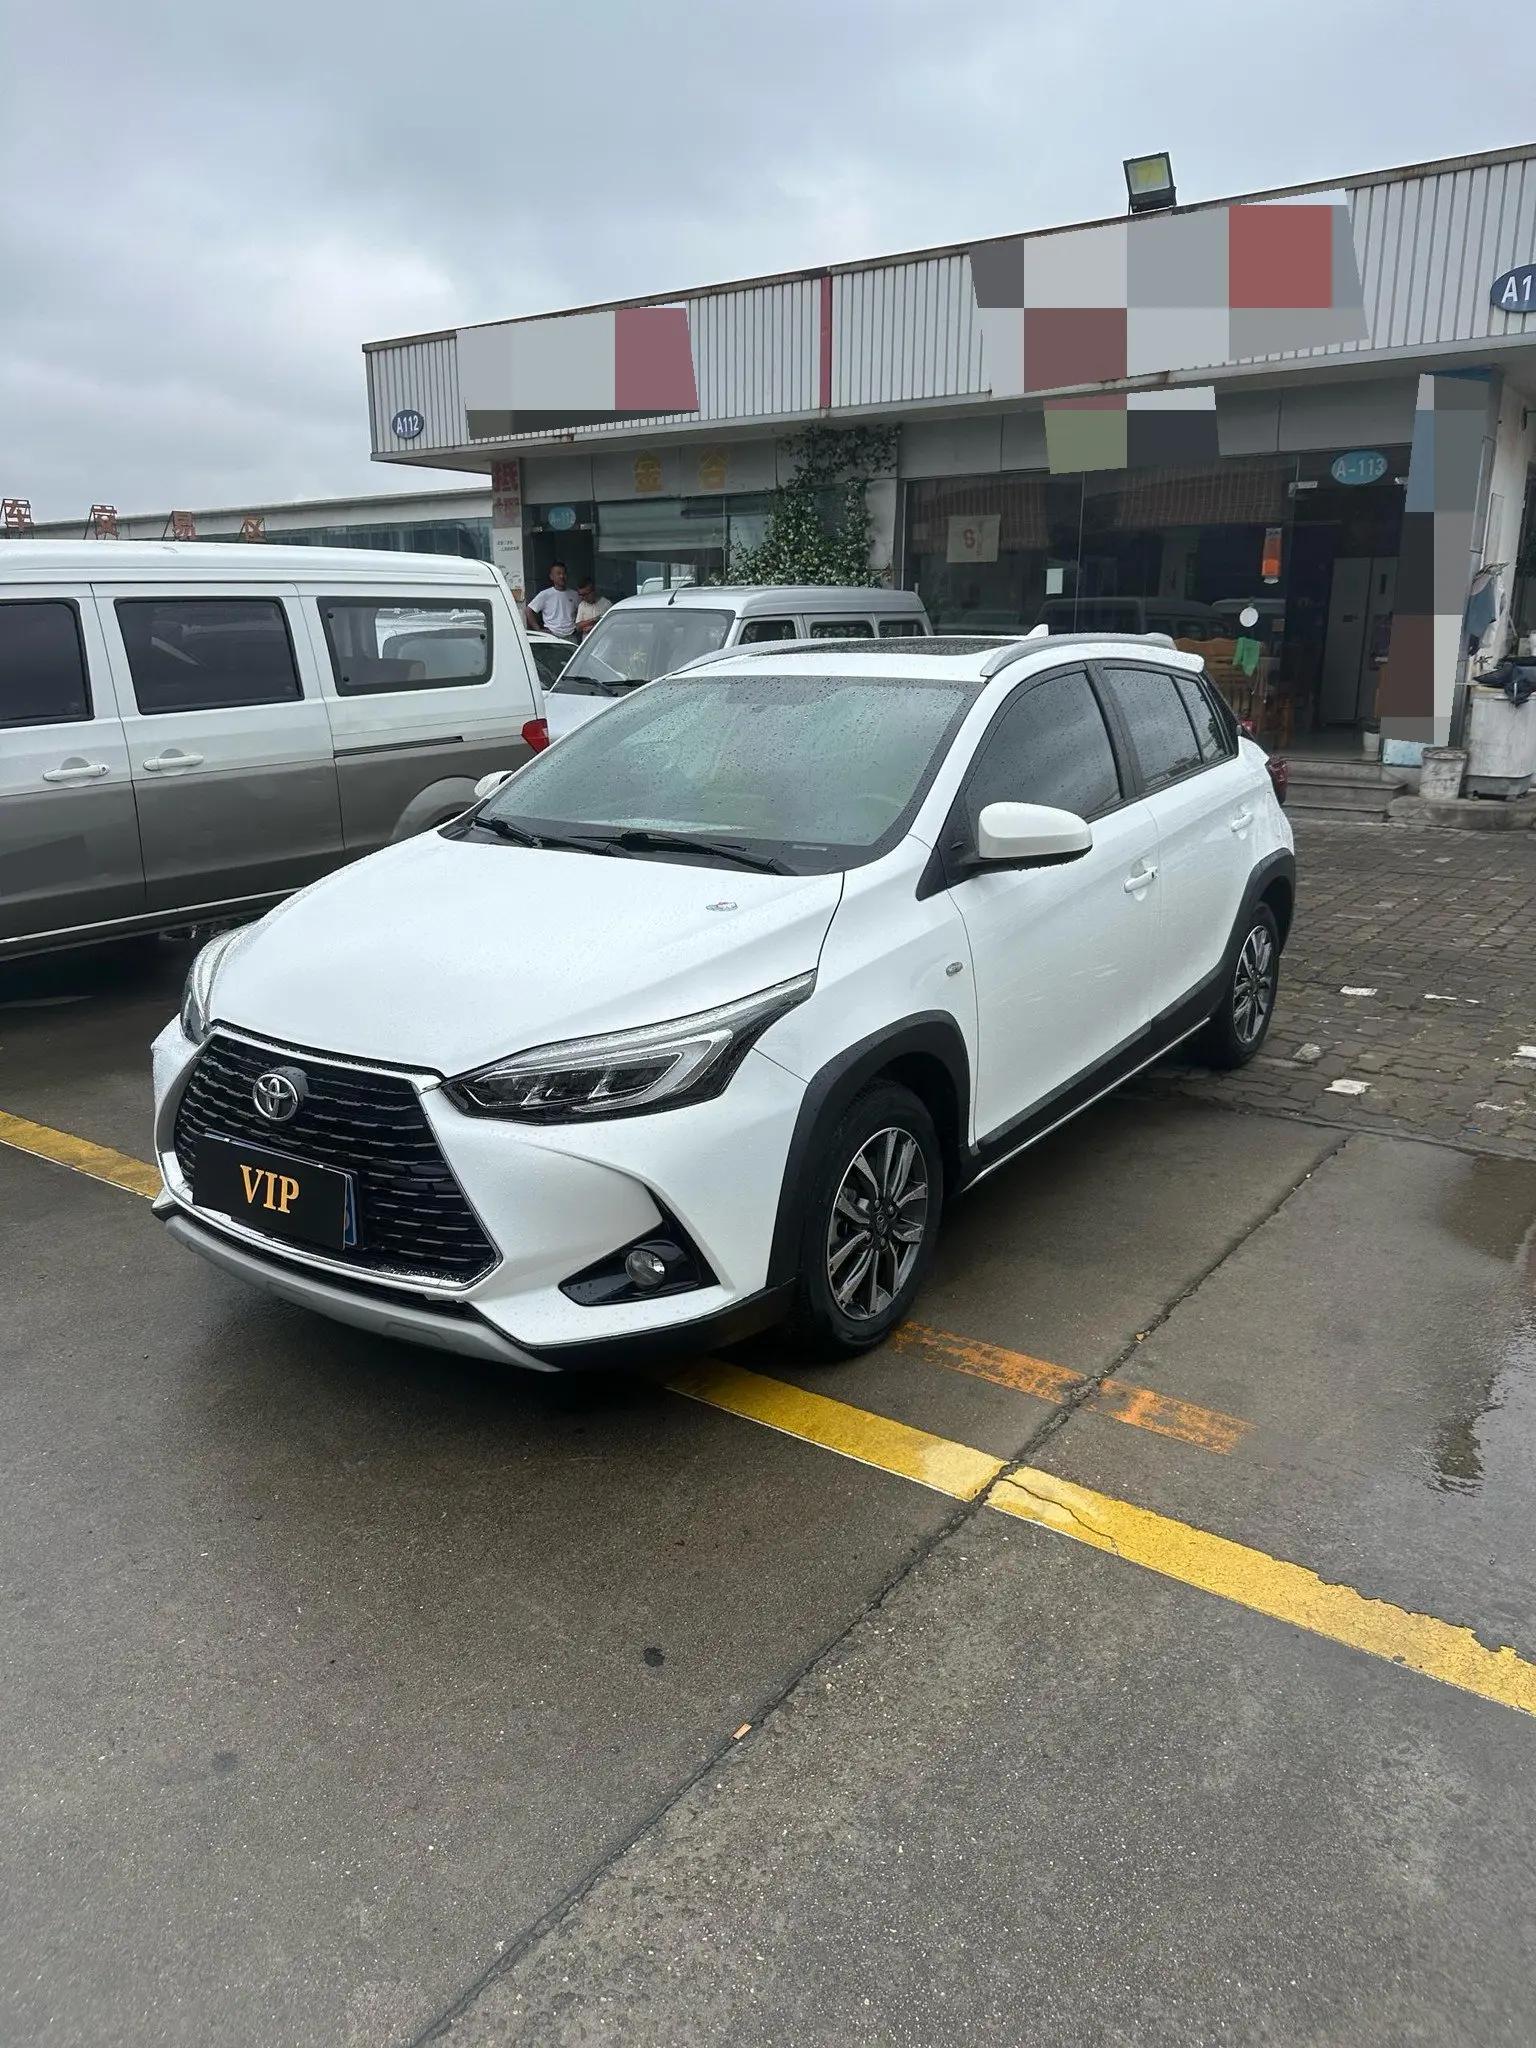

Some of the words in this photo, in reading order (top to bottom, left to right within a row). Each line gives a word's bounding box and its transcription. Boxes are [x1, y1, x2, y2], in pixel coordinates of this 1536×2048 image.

[1501, 274, 1532, 303] A1
[396, 414, 419, 434] A112
[1336, 457, 1384, 478] A-113
[239, 1164, 300, 1214] VIP
